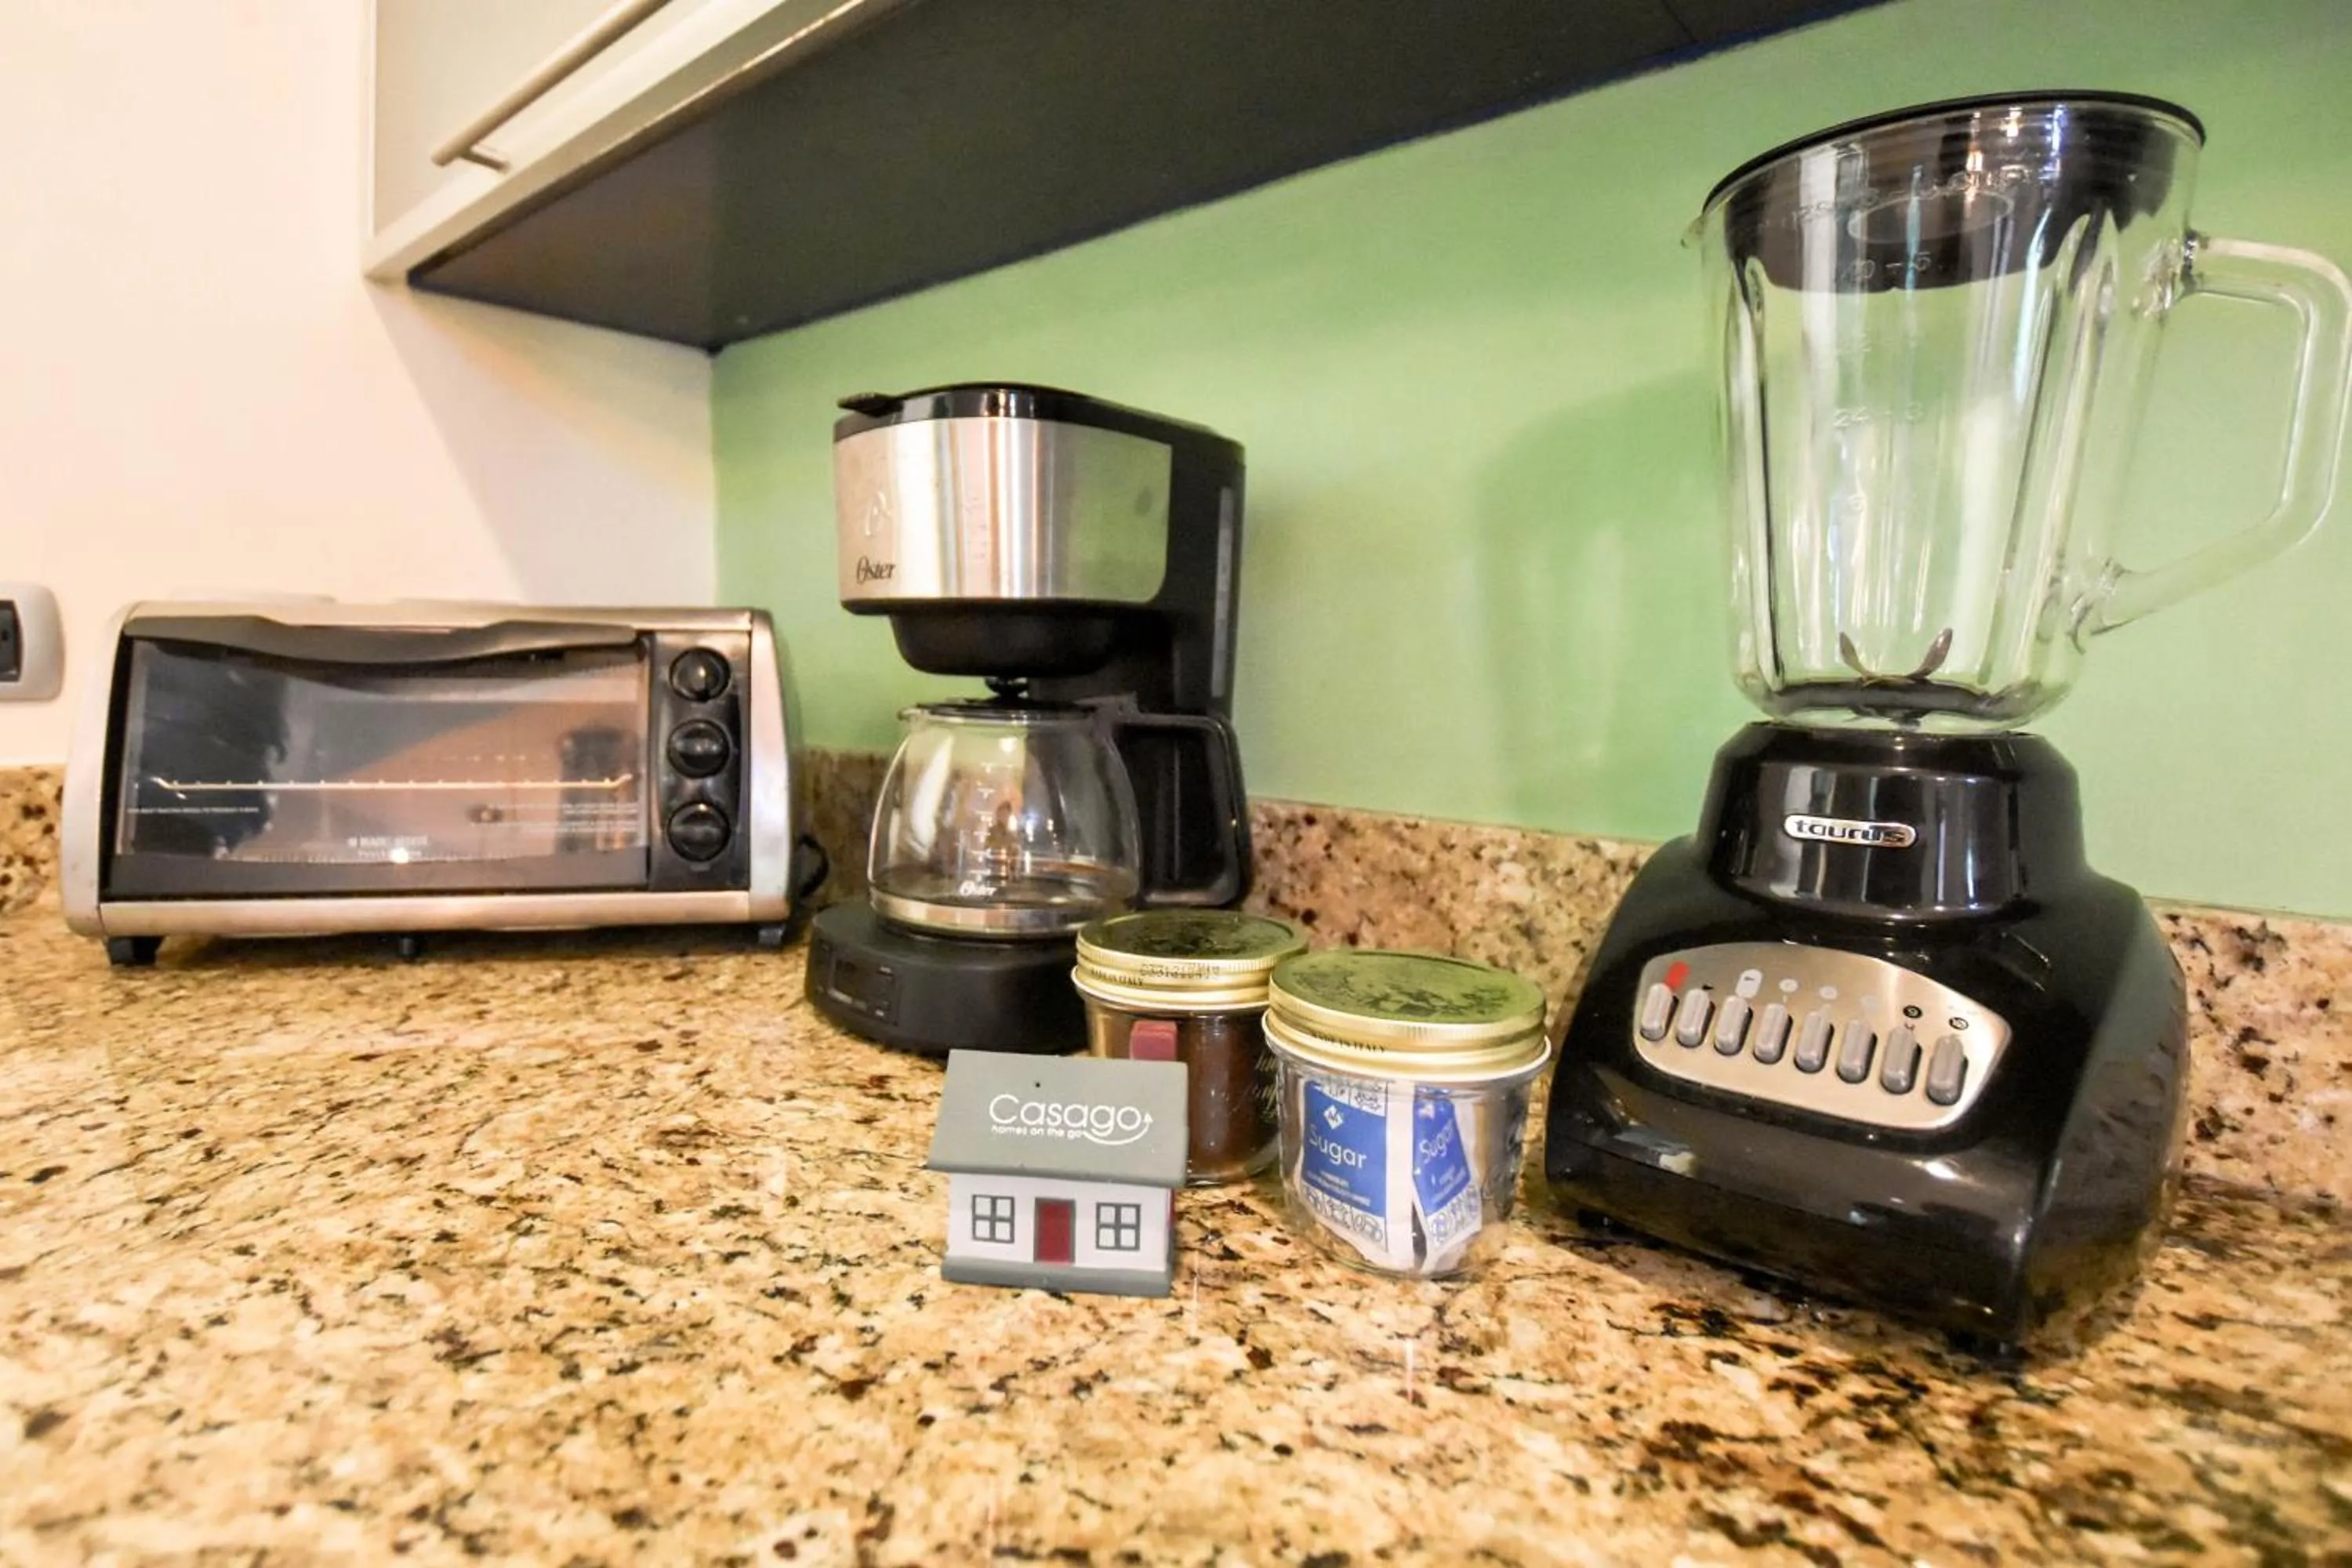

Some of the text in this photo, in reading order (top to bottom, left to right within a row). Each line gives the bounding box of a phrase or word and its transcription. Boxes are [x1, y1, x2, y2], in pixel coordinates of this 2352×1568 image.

[856, 555, 896, 585] Oster
[1795, 819, 1906, 844] taurus
[989, 1094, 1142, 1137] Casago
[1030, 1127, 1044, 1136] on
[1047, 1127, 1065, 1137] the
[1067, 1130, 1083, 1139] go
[1308, 1123, 1367, 1169] Sugar
[1419, 1118, 1454, 1164] Sugar
